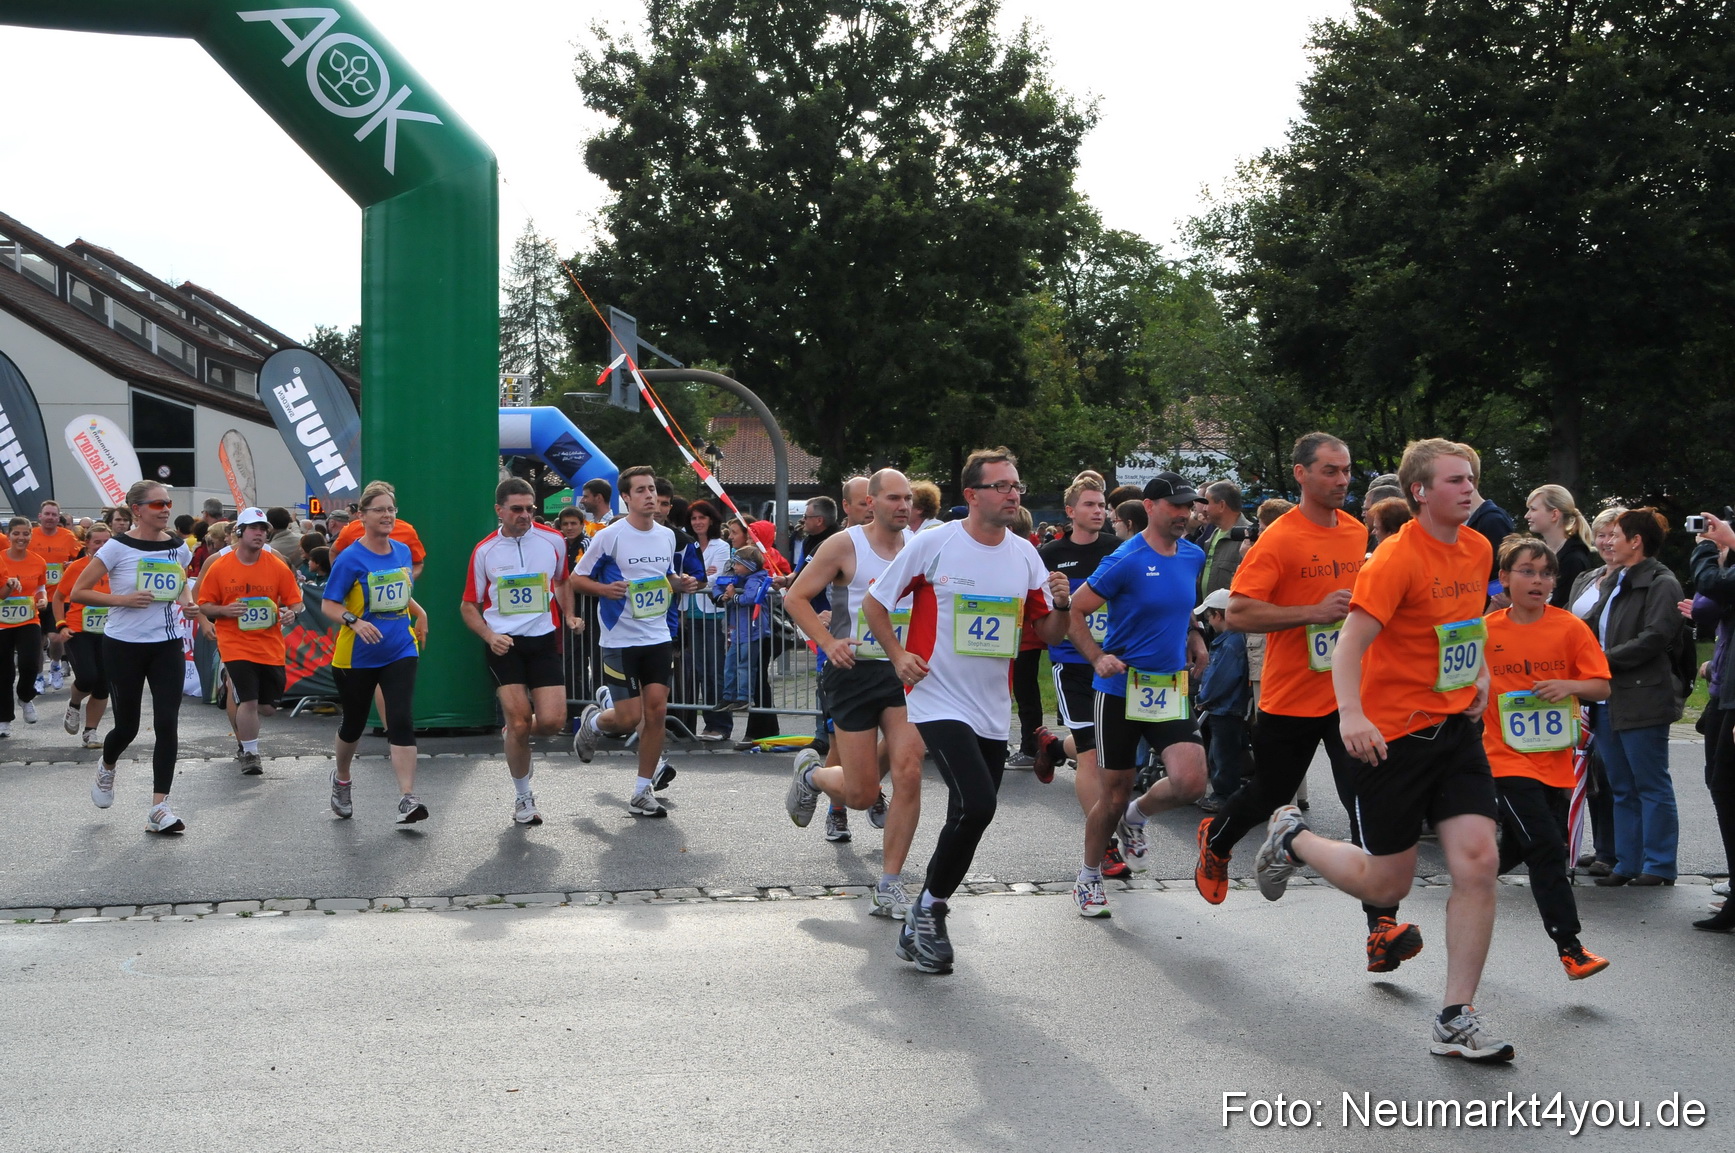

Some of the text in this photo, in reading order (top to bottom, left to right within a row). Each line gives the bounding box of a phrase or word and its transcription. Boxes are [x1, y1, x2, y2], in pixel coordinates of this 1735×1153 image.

[236, 7, 444, 176] AOK
[628, 556, 671, 565] DELPHI
[1301, 564, 1332, 578] EURO
[142, 573, 176, 591] 766
[224, 584, 274, 594] EURO POLES
[375, 582, 404, 602] 767
[509, 587, 533, 604] 38
[635, 589, 665, 609] 924
[2, 606, 27, 618] 570
[862, 625, 903, 646] 41
[968, 616, 1000, 641] 42
[967, 640, 991, 648] Stephan
[1443, 642, 1477, 674] 590
[1493, 660, 1566, 676] EURO POLES
[1139, 687, 1167, 709] 34
[1509, 710, 1563, 737] 618
